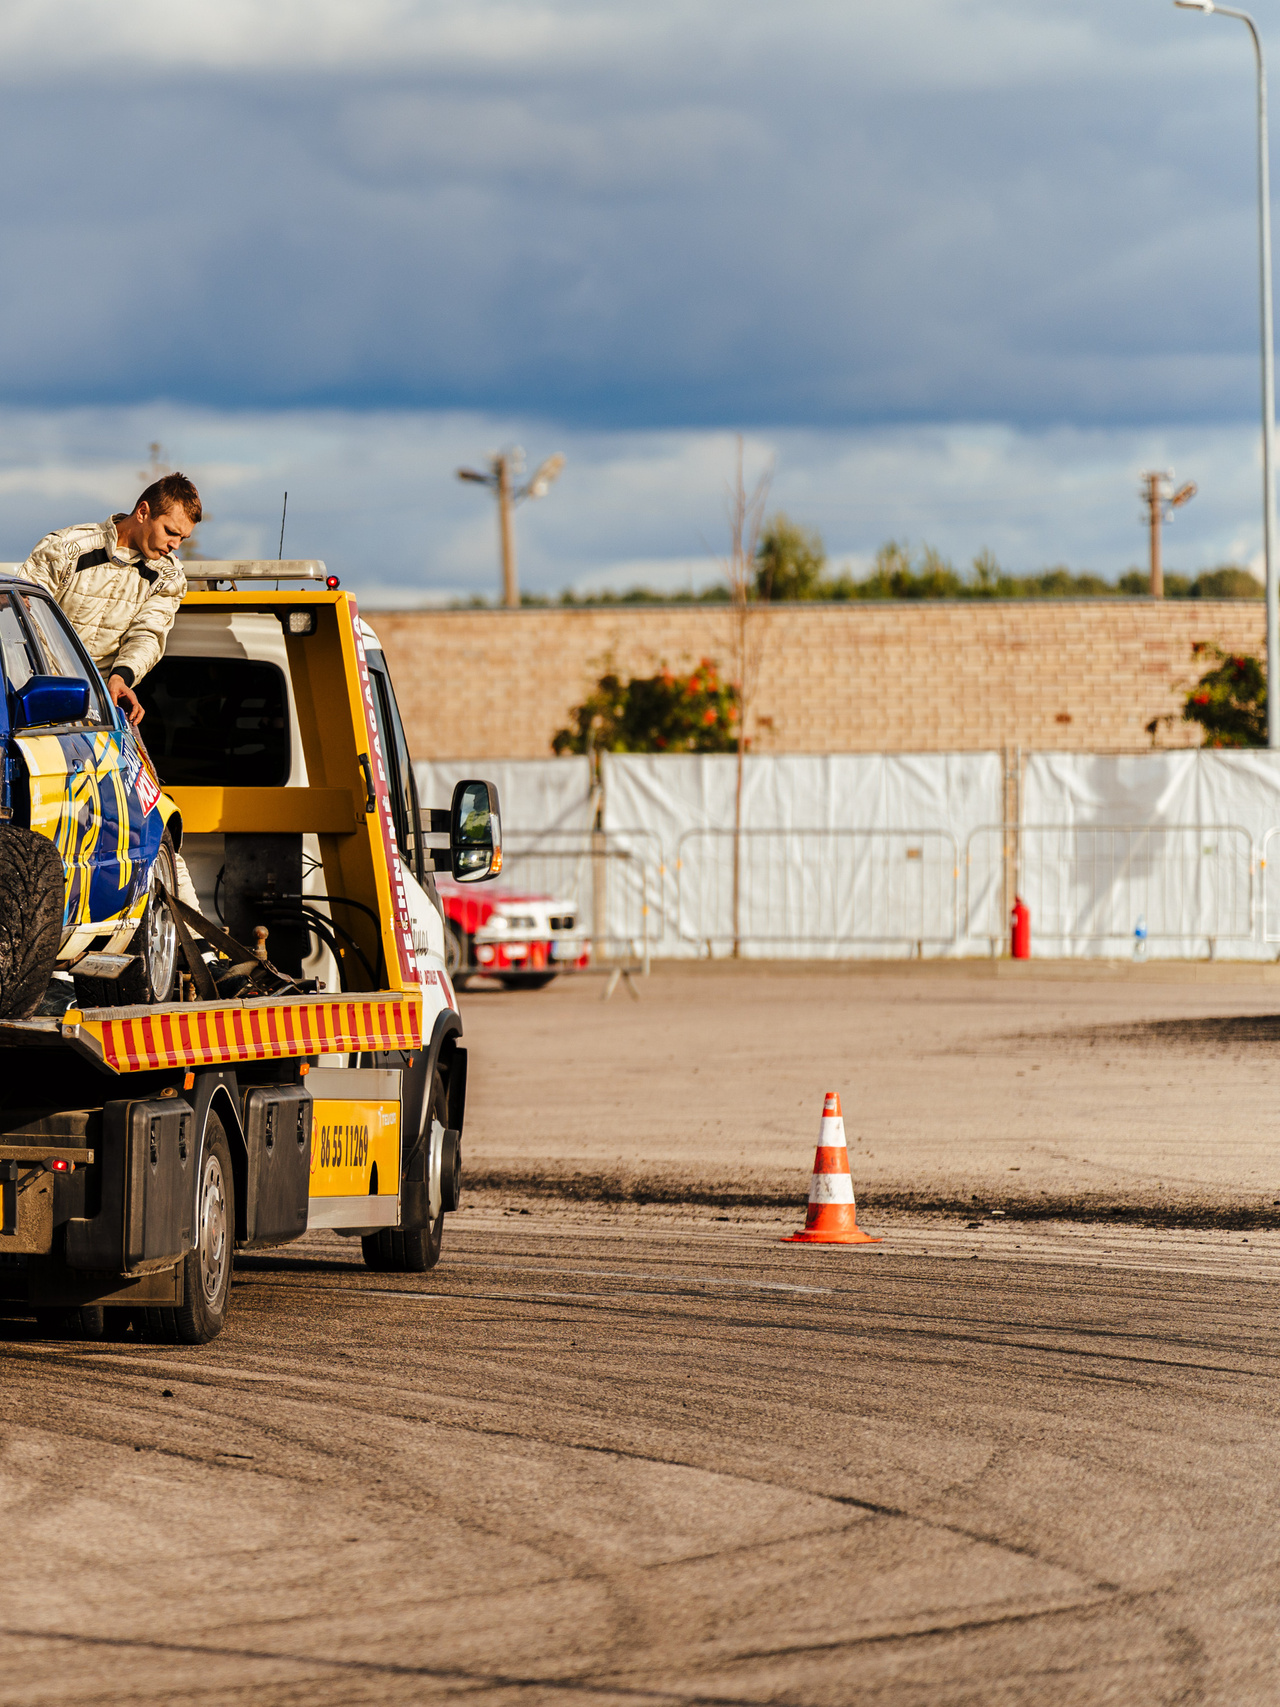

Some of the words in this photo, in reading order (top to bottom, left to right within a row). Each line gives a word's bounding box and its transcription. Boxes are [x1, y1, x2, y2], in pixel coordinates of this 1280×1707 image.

[352, 614, 387, 782] PAGALBA
[320, 1125, 331, 1168] 86
[331, 1125, 343, 1168] 55
[344, 1124, 369, 1167] 11269
